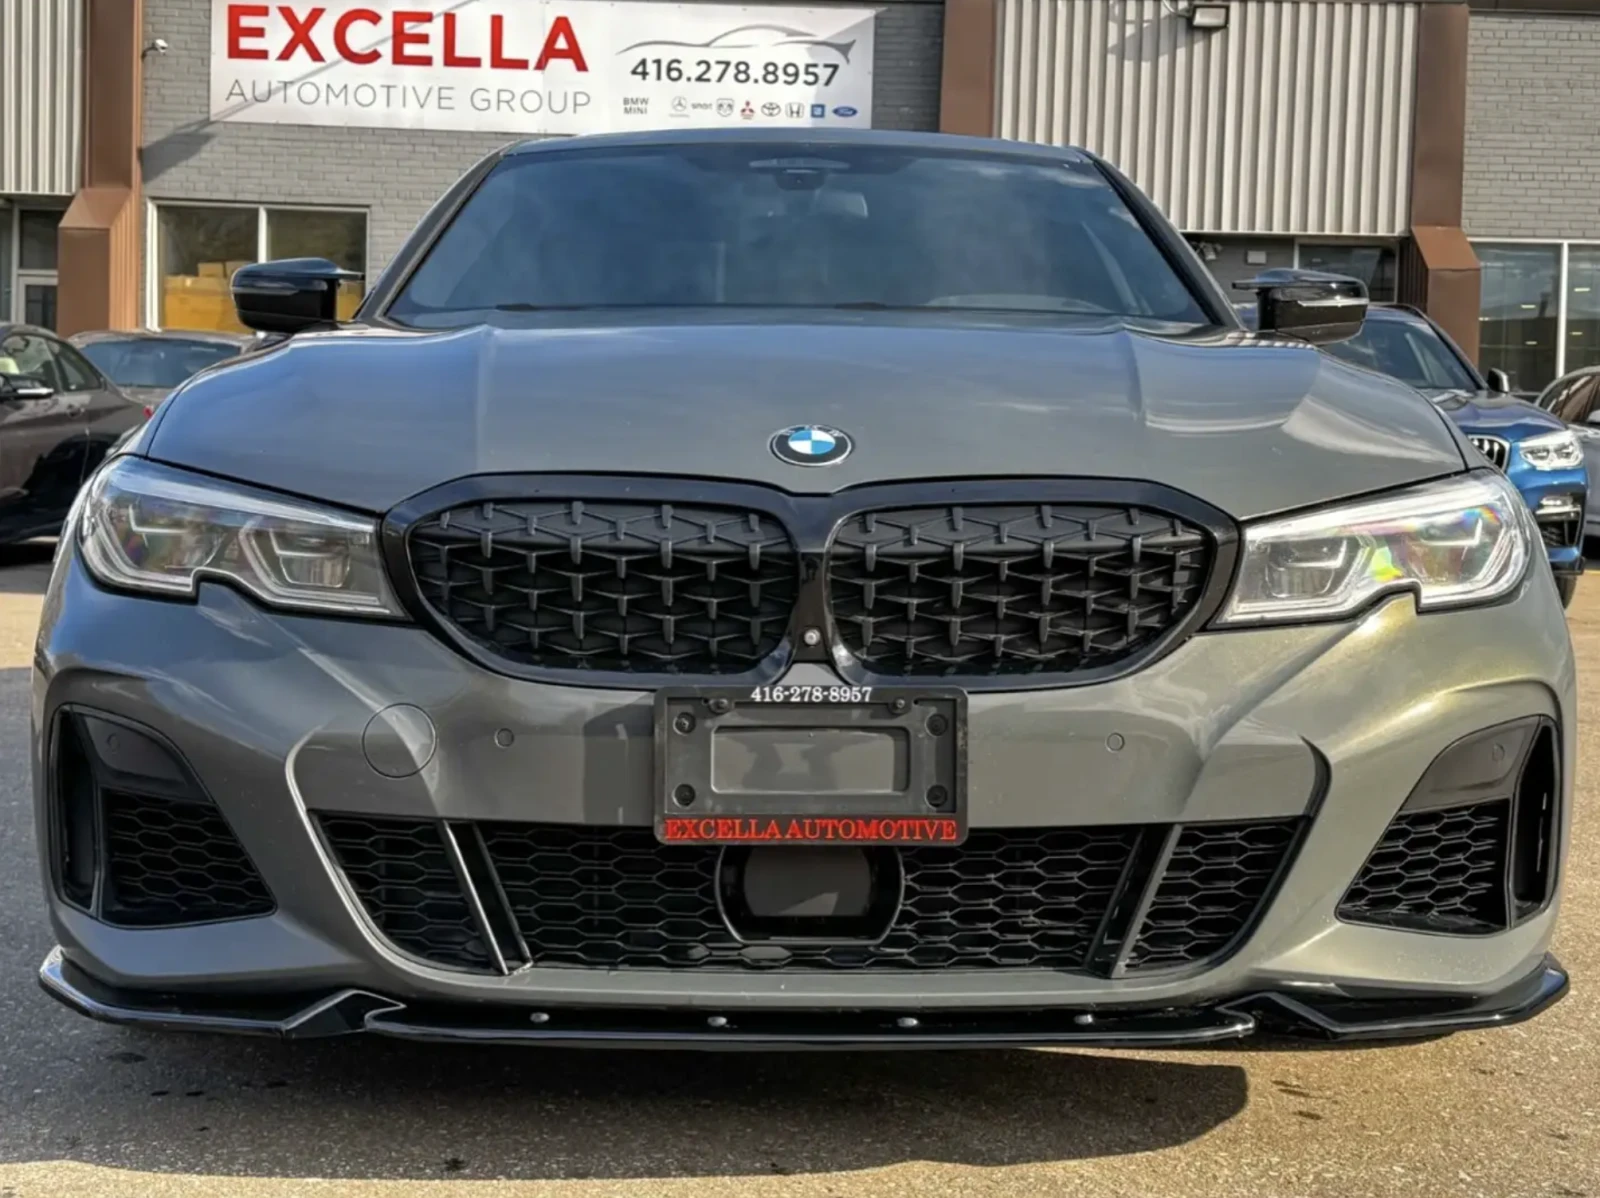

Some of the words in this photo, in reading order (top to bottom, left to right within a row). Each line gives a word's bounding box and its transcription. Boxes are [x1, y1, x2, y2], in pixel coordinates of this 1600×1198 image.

[227, 4, 589, 72] EXCELLA
[630, 58, 840, 87] 416.278.8957
[225, 79, 455, 110] AUTOMOTIVE
[470, 88, 591, 114] GROUP
[623, 97, 649, 106] BMW
[624, 106, 648, 115] MINI
[751, 686, 873, 702] 416-278-8957
[665, 818, 781, 841] EXCELLA
[783, 818, 958, 841] AUTOMOTIVE
